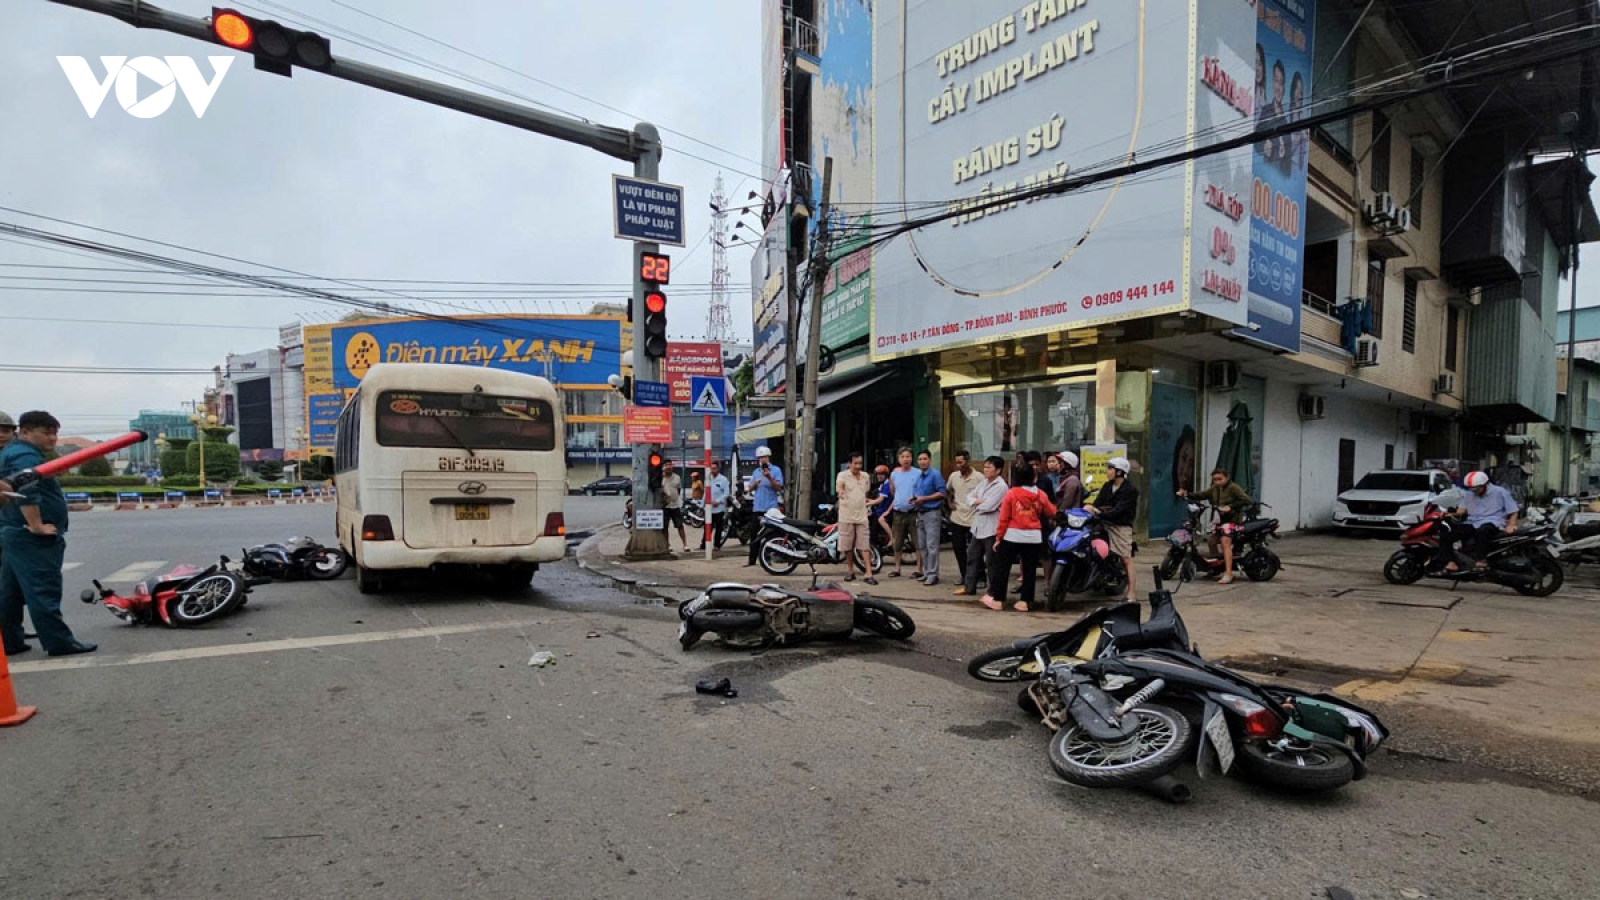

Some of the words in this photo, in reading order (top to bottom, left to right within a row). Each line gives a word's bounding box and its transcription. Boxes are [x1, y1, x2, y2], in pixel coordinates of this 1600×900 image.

[935, 15, 1016, 79] TRUNG
[927, 81, 970, 124] CẤY
[974, 19, 1099, 104] IMPLANT
[1026, 112, 1066, 158] SỨ
[619, 184, 643, 198] VƯỢT
[665, 191, 678, 203] ĐỎ
[623, 199, 636, 210] LÀ
[637, 202, 647, 212] VI
[648, 203, 676, 217] PHẠM
[624, 213, 651, 226] PHÁP
[652, 218, 675, 231] LUẬT
[1211, 226, 1236, 265] 0%
[641, 255, 668, 282] 22
[1095, 290, 1123, 306] 0909
[1126, 284, 1148, 300] 444
[1153, 279, 1174, 296] 144
[996, 309, 1012, 325] XOÀI
[1019, 305, 1039, 321] BÌNH
[1040, 300, 1068, 317] PHƯỚC
[440, 339, 498, 367] máy
[499, 338, 596, 363] XANH
